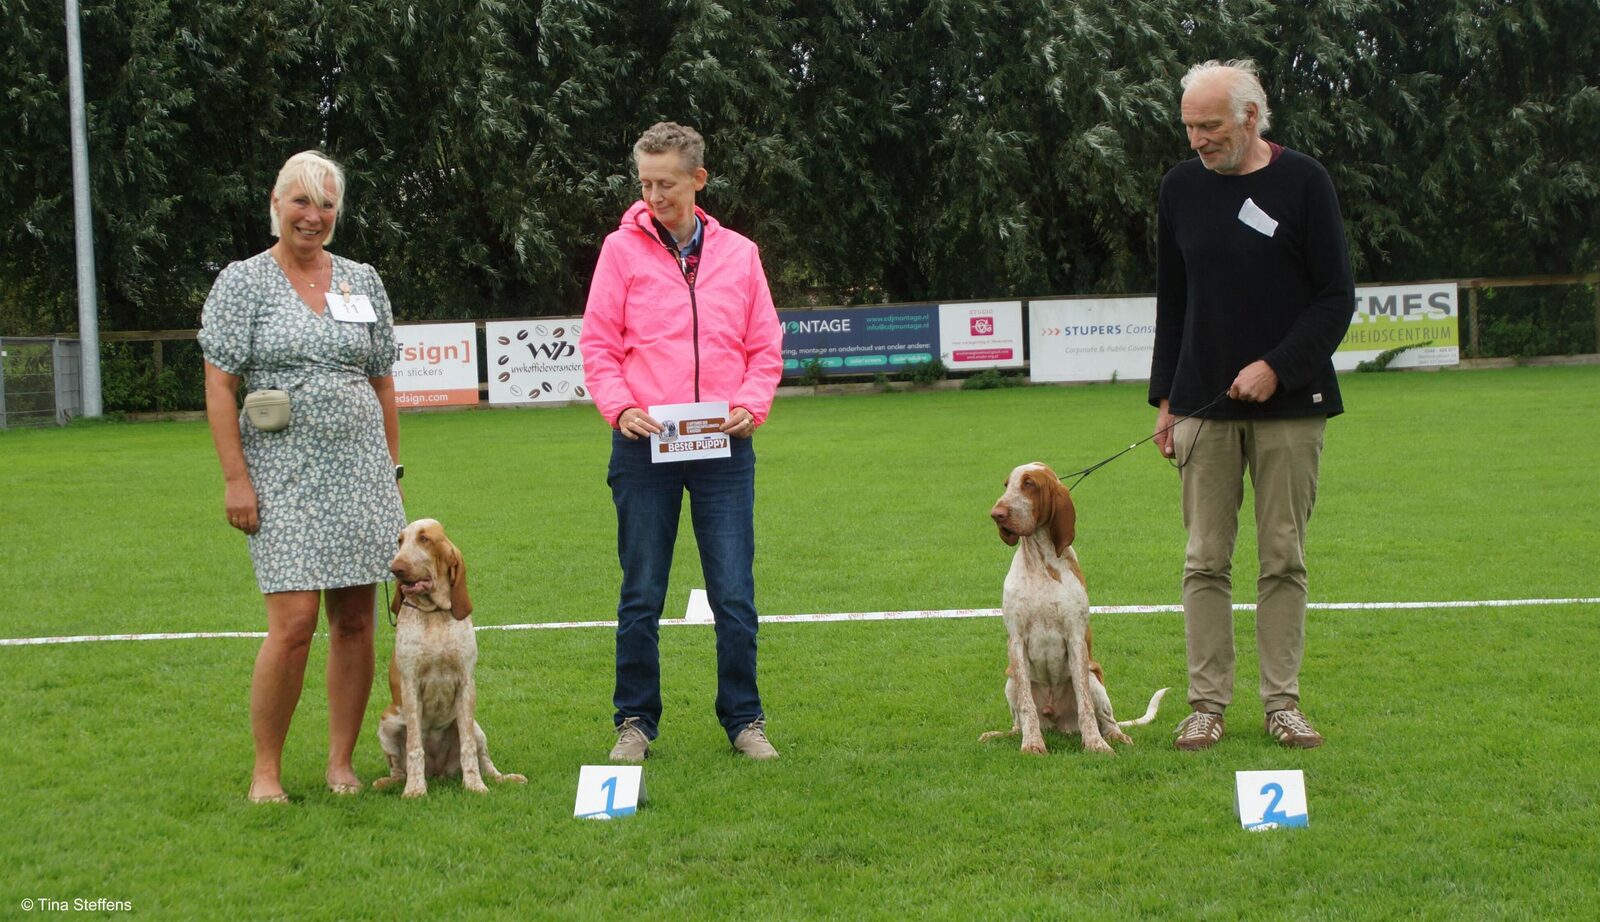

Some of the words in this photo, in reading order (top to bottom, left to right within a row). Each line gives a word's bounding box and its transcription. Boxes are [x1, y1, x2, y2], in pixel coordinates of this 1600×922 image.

[1065, 325, 1121, 336] STUPERS
[838, 344, 873, 353] onderhoud
[407, 366, 444, 377] stickers
[601, 776, 617, 817] 1
[1260, 782, 1286, 823] 2
